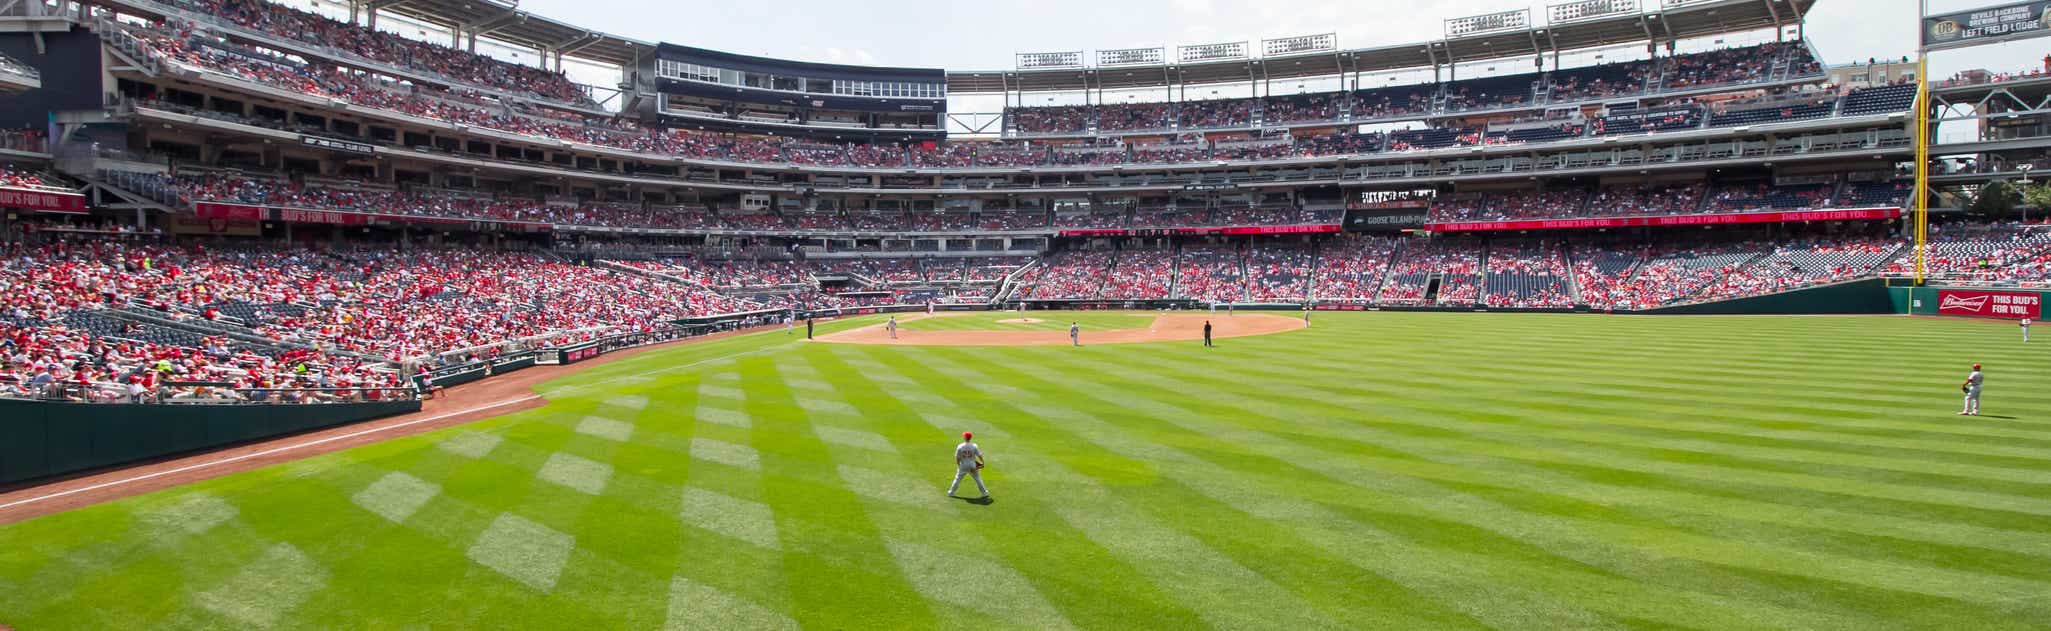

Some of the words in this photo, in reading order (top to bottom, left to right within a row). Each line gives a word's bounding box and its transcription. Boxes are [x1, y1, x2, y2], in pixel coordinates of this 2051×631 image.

[1971, 11, 1993, 20] DEVILS
[1995, 5, 2030, 16] BACKBONE
[1969, 17, 1998, 27] BREWING
[2000, 12, 2031, 22] COMPANY
[1962, 28, 1983, 38] LEFT
[1985, 24, 2008, 35] FIELD
[2010, 20, 2039, 32] LODGE
[23, 193, 40, 206] FOR
[307, 211, 323, 223] FOR
[1368, 216, 1388, 225] GOOSE
[1830, 211, 1847, 219] FOR
[1992, 295, 2011, 304] THIS
[2013, 296, 2038, 306] BUD'S
[1992, 305, 2008, 313] FOR
[2010, 305, 2029, 315] YOU.
